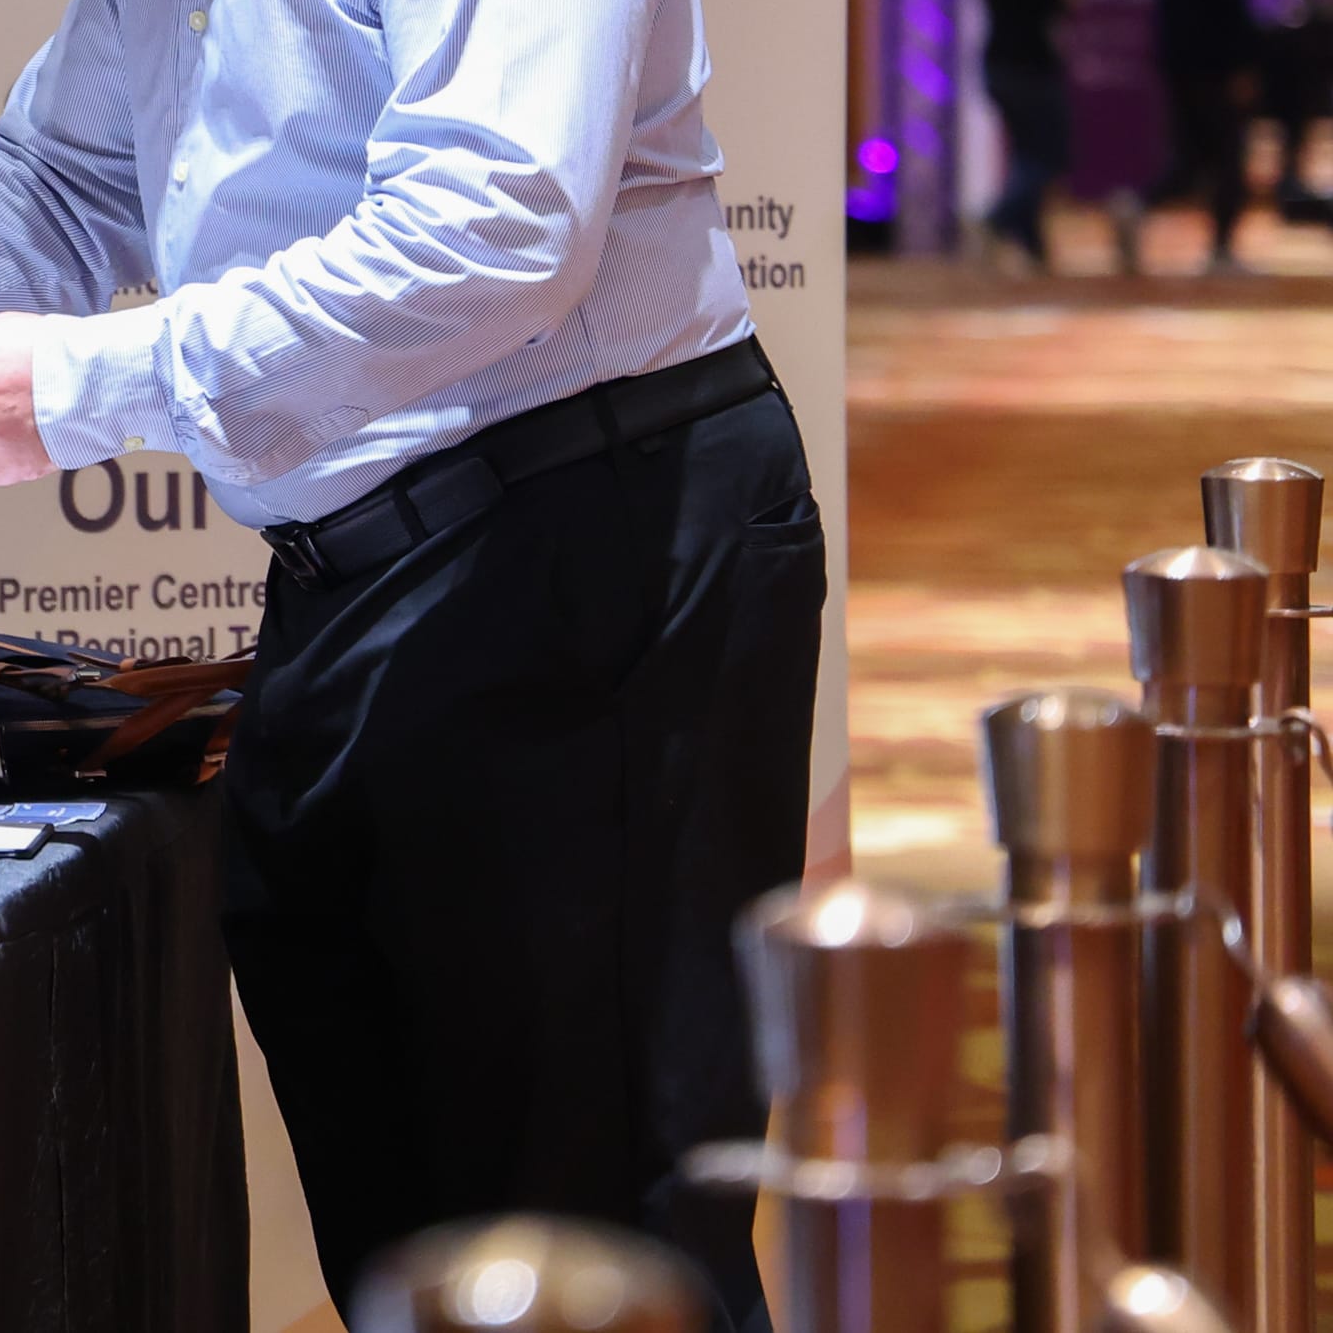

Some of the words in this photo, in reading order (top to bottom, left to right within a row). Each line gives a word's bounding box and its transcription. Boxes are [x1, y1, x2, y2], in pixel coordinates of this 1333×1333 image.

[725, 195, 794, 240] nity
[738, 254, 805, 290] tion
[151, 573, 267, 611] Centre
